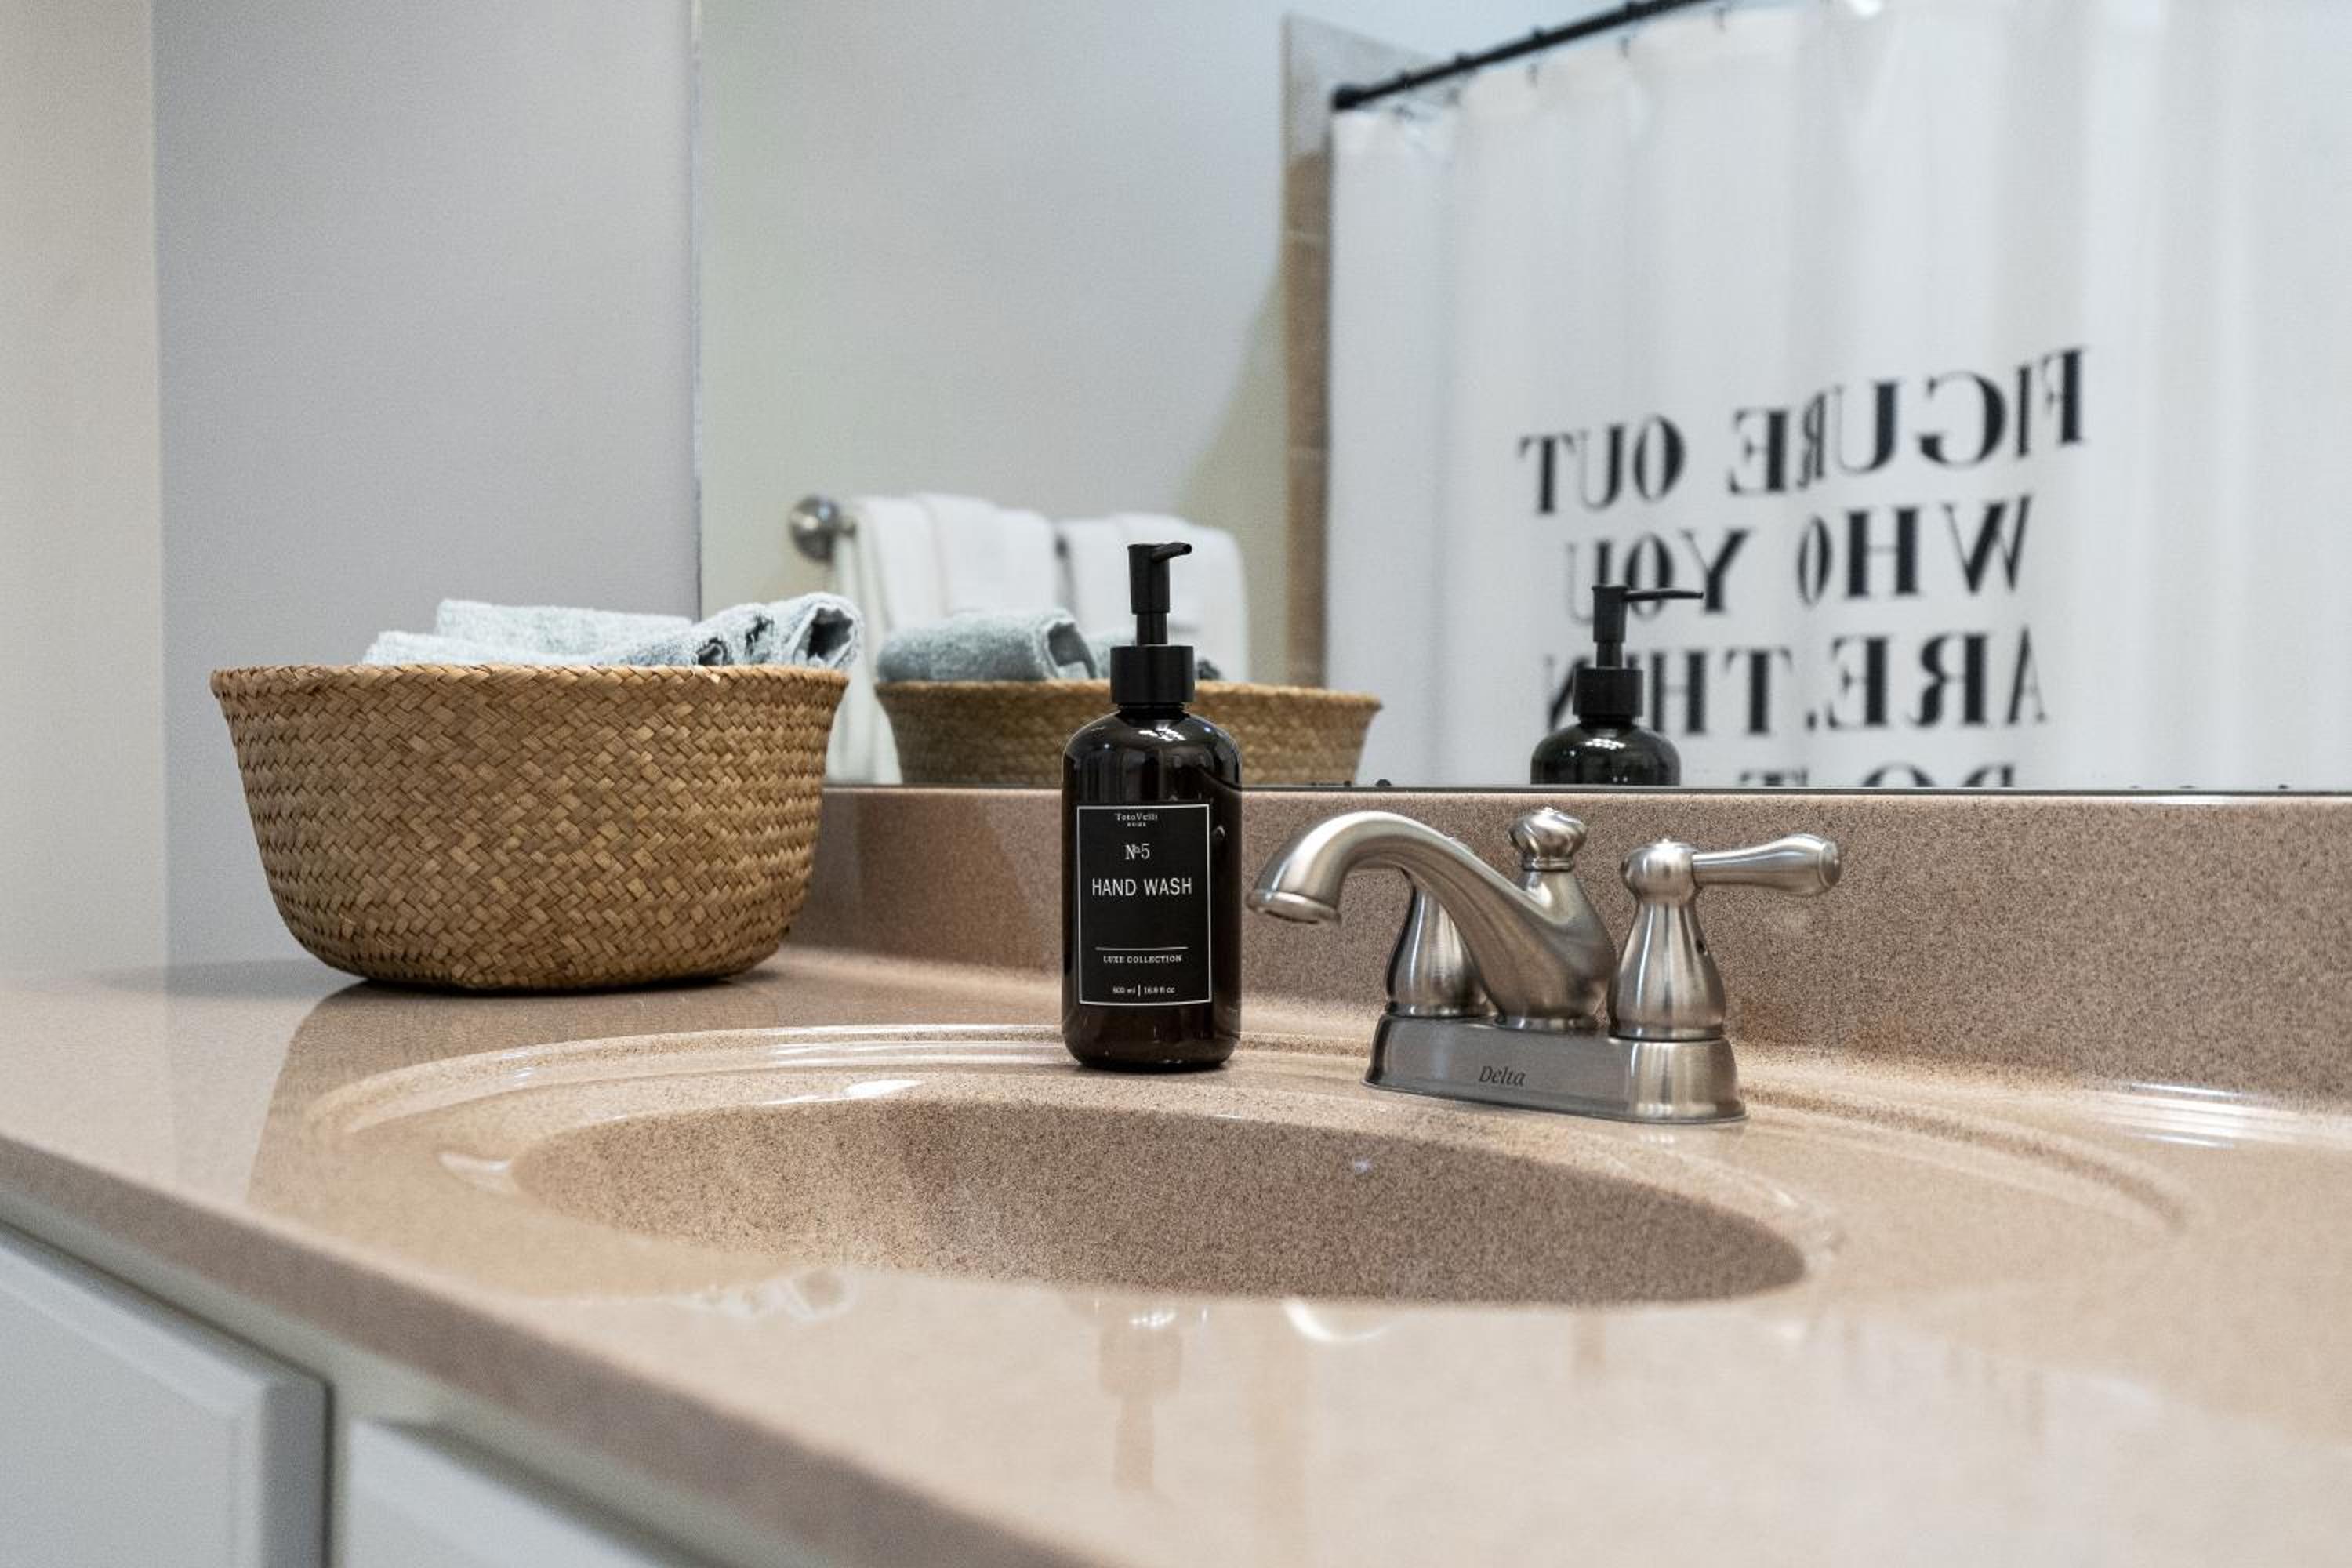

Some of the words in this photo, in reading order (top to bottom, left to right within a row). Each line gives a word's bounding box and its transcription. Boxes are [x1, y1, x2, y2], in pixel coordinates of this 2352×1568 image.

[1092, 877, 1137, 896] HAND
[1144, 877, 1192, 896] WASH
[1127, 954, 1182, 964] COLLECTION
[1478, 1065, 1526, 1087] Delta
